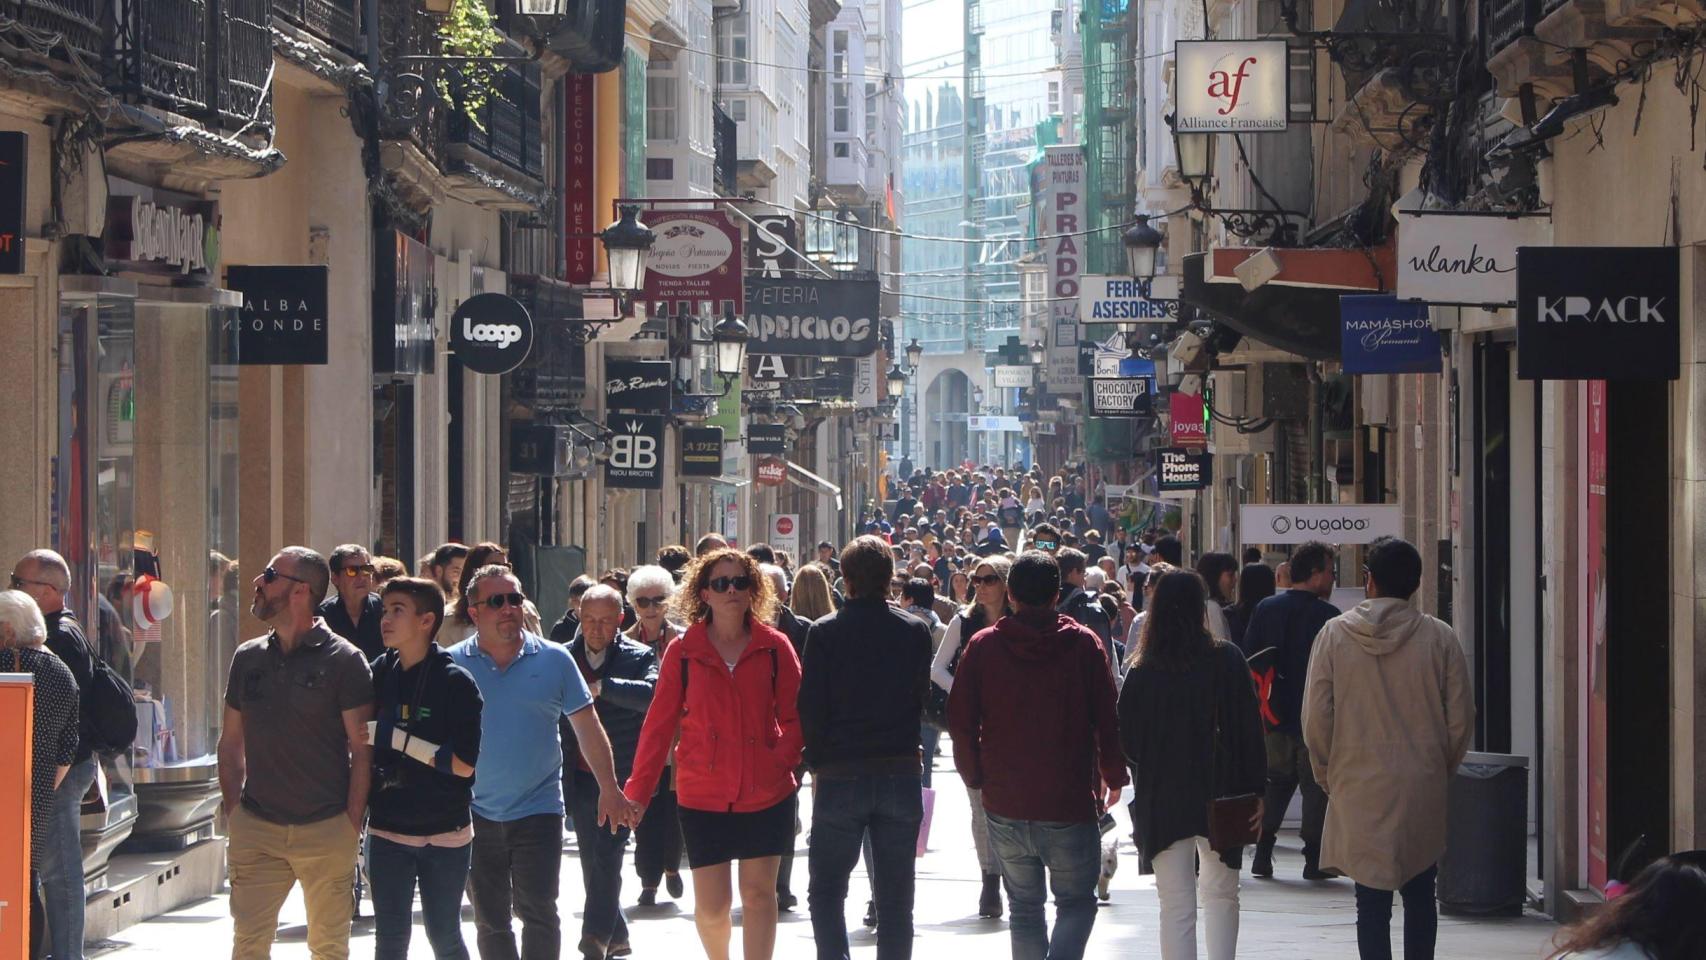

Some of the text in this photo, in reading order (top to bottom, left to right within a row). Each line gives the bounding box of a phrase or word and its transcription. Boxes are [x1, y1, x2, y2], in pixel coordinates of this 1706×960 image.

[1208, 57, 1257, 115] af
[1180, 117, 1228, 129] Alliance
[1047, 154, 1083, 167] TALLERES DE
[1052, 170, 1079, 183] PINTURAS
[1055, 192, 1079, 298] PRADO
[1408, 243, 1518, 274] ulanka
[244, 299, 308, 311] ALBA
[1092, 301, 1167, 319] ASESORES
[1537, 296, 1665, 323] KRACK
[1097, 395, 1134, 407] FACTORY
[1162, 453, 1186, 462] The
[1162, 463, 1200, 472] Phone
[1163, 473, 1200, 482] House
